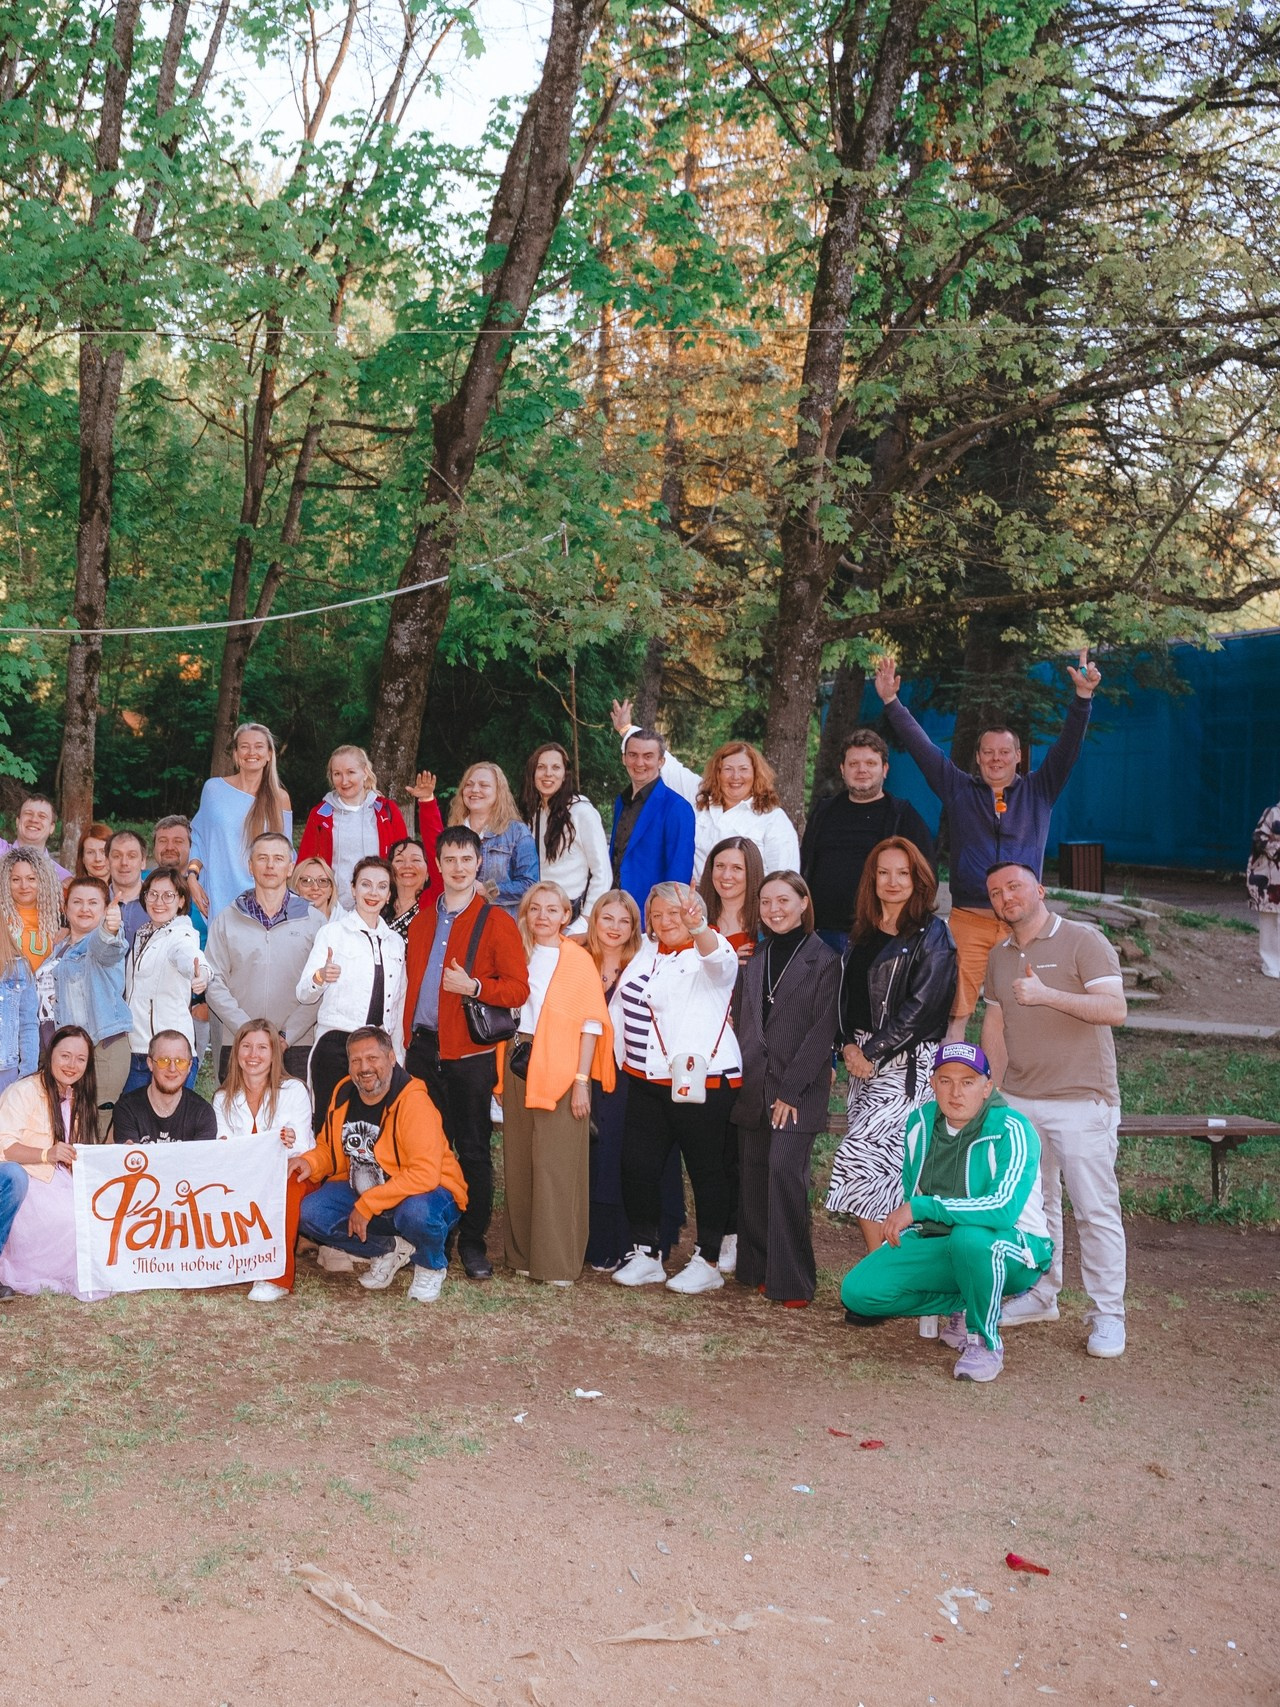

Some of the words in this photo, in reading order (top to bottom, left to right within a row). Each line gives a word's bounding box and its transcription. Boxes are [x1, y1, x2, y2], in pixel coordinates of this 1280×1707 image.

[132, 1256, 175, 1275] Твои
[180, 1254, 223, 1272] новые
[228, 1247, 277, 1276] друзья!
